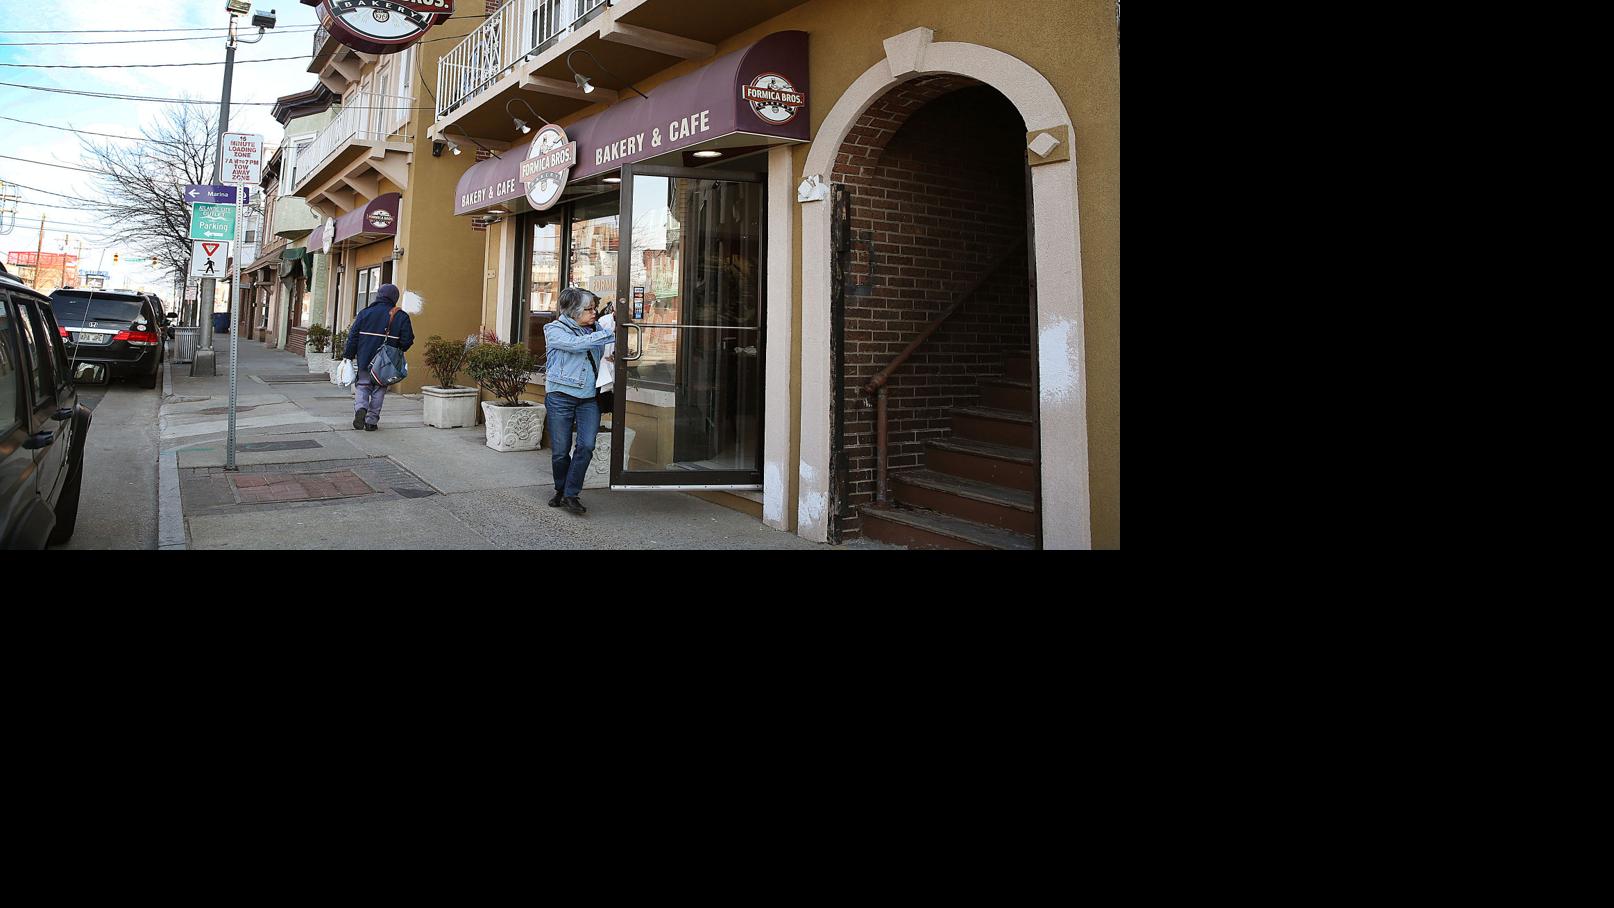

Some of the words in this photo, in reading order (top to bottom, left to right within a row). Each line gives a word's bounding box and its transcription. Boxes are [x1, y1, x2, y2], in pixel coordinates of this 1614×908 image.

[344, 1, 418, 17] BAKERY
[747, 88, 780, 101] FORMICA
[781, 92, 803, 104] BROS.
[595, 132, 645, 166] BAKERY
[651, 127, 662, 148] &
[669, 110, 710, 142] CAFE
[522, 156, 549, 177] FORMICA
[550, 148, 572, 167] BROS.
[461, 188, 487, 207] BAKERY
[488, 185, 494, 199] &
[496, 178, 516, 197] CAFE
[199, 221, 229, 232] Parking
